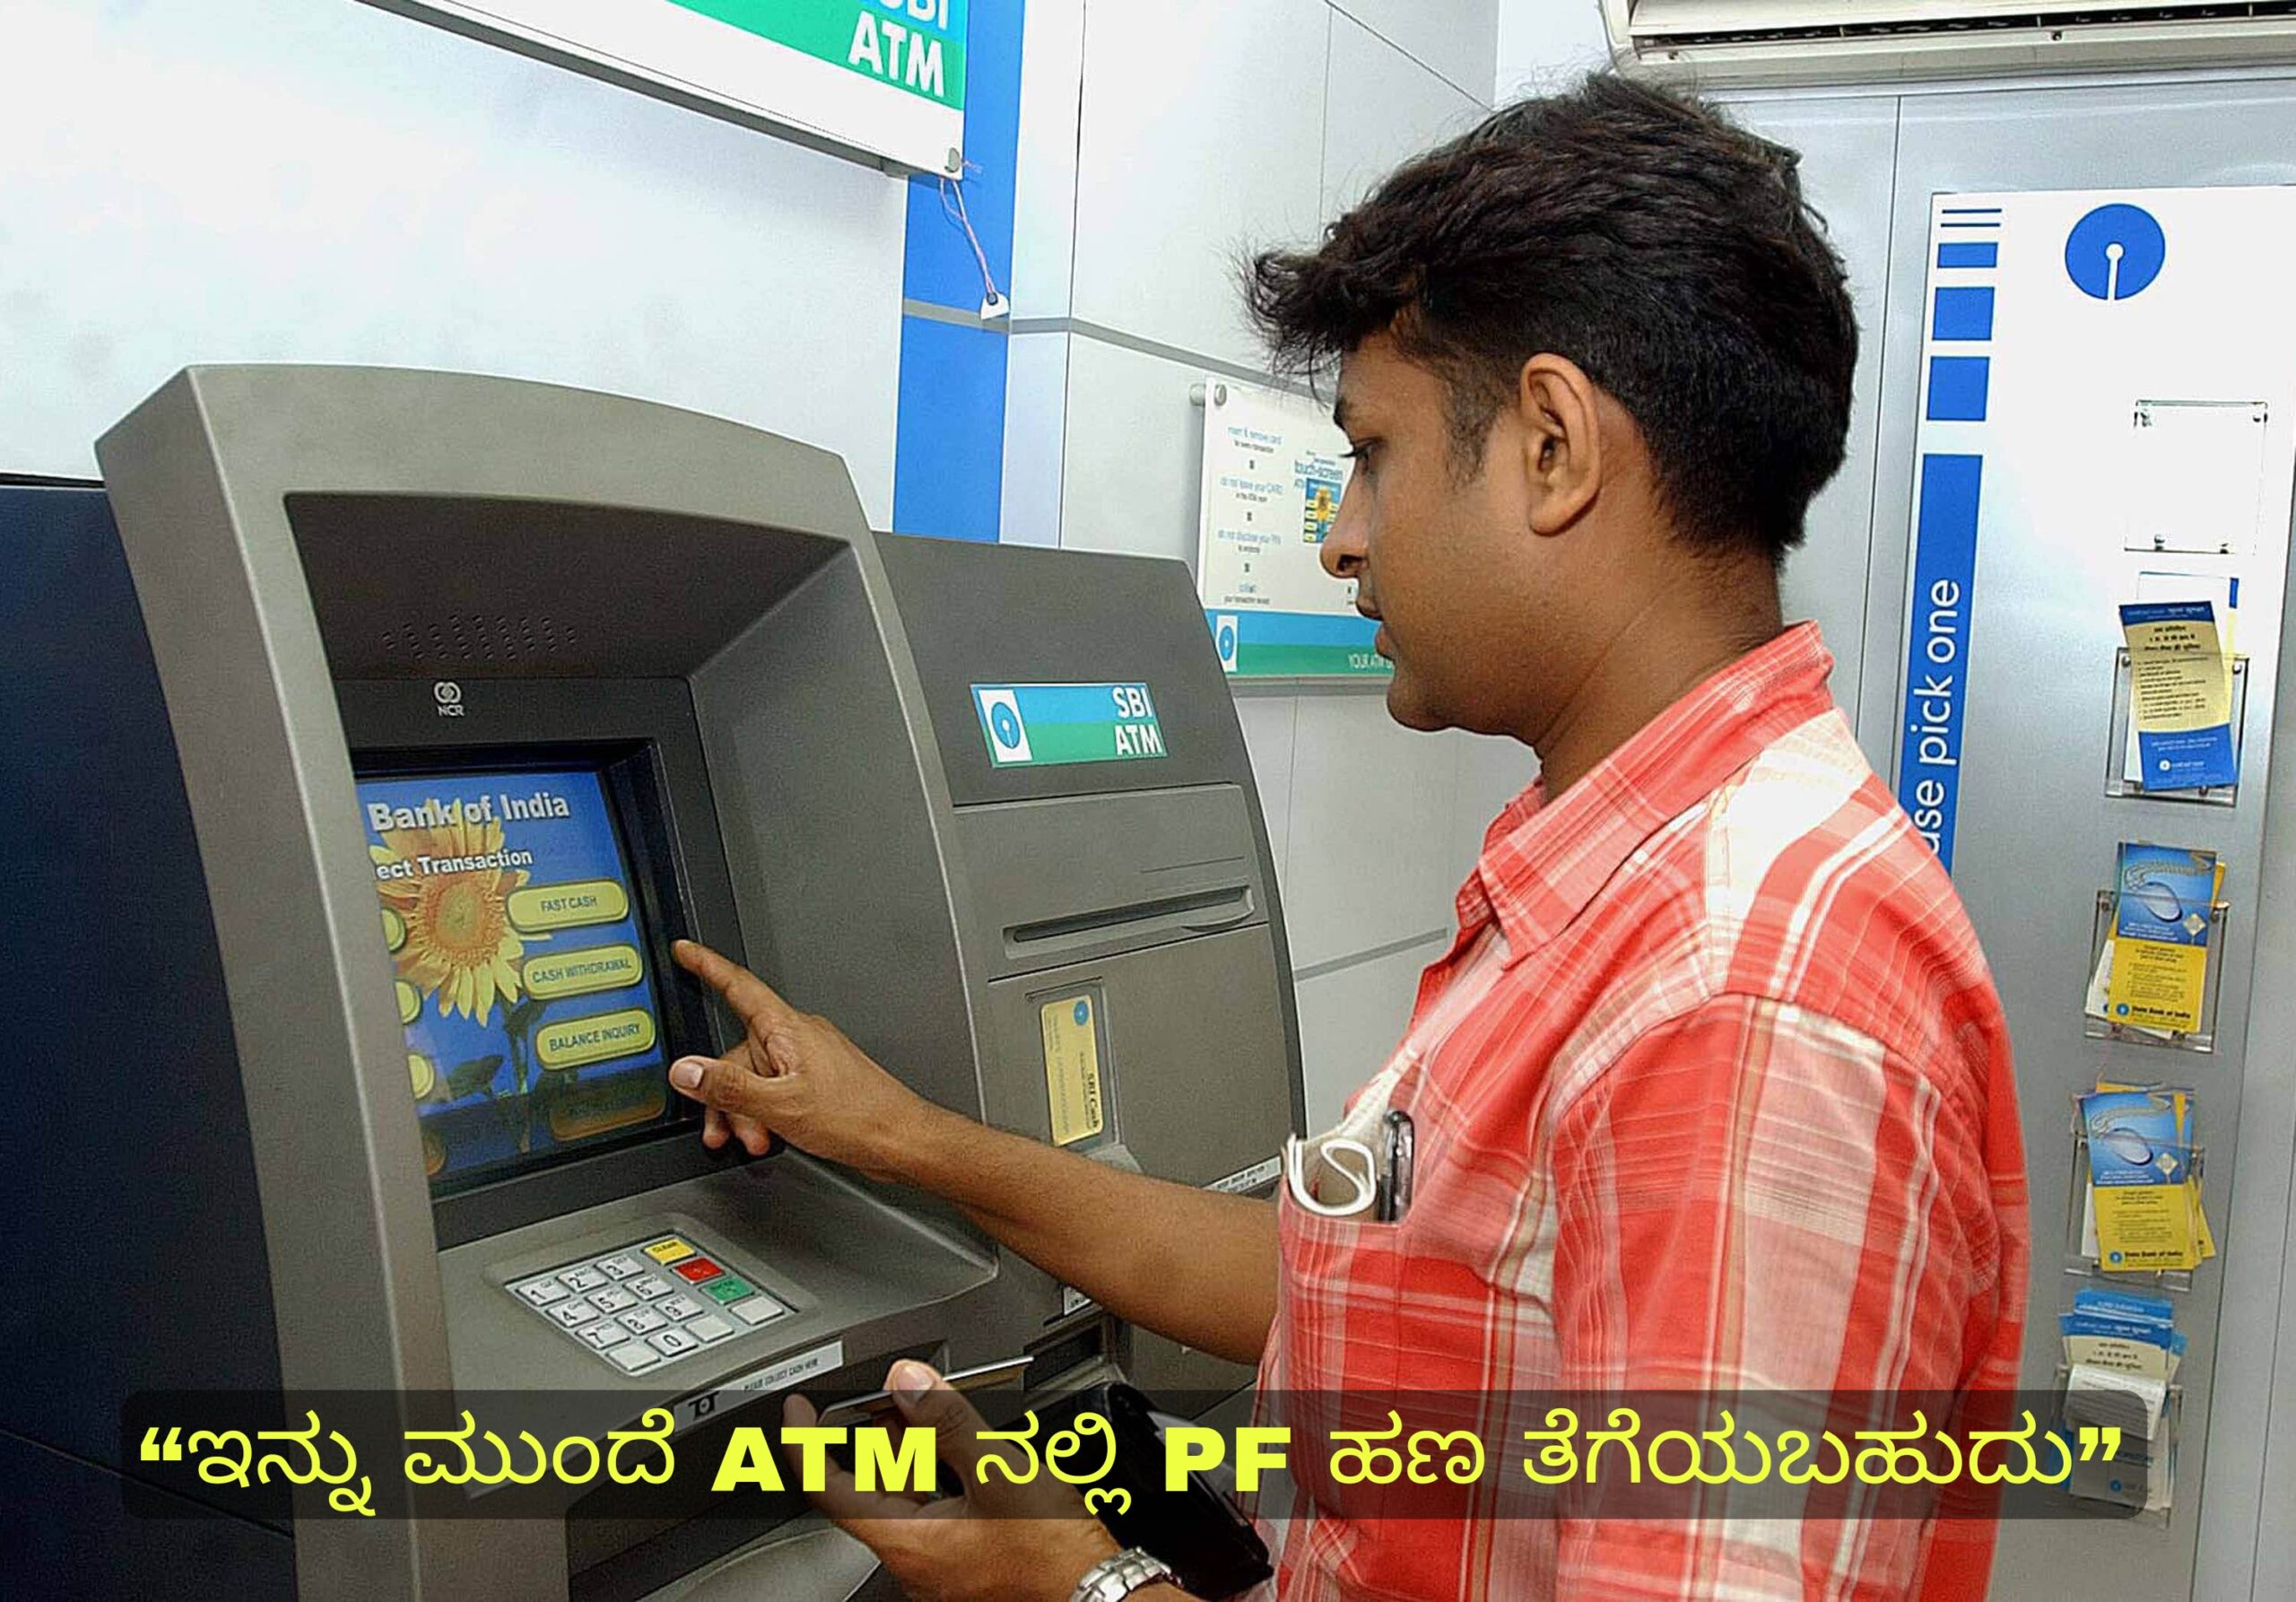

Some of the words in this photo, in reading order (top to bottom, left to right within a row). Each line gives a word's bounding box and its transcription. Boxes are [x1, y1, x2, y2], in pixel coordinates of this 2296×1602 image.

[848, 10, 944, 98] ATM
[1927, 579, 1960, 663] one
[438, 704, 465, 716] NCR
[1112, 686, 1153, 718] SBI
[1910, 675, 1957, 765] pick
[1115, 724, 1163, 755] ATM
[367, 799, 456, 831] Bank
[464, 796, 492, 823] of
[500, 792, 570, 821] India
[377, 860, 413, 880] ect
[417, 849, 534, 875] Transaction
[541, 899, 568, 913] FAST
[569, 895, 598, 910] CASH
[533, 967, 565, 984] CASH
[566, 958, 633, 979] WITHDRAWAL
[549, 1030, 602, 1052] BALANCE
[603, 1023, 641, 1042] INQUIRY
[530, 1289, 546, 1300] 1
[569, 1277, 587, 1288] 2
[562, 1310, 578, 1322] 4
[598, 1297, 615, 1309] 5
[587, 1331, 604, 1345] 7
[663, 1334, 683, 1347] 0
